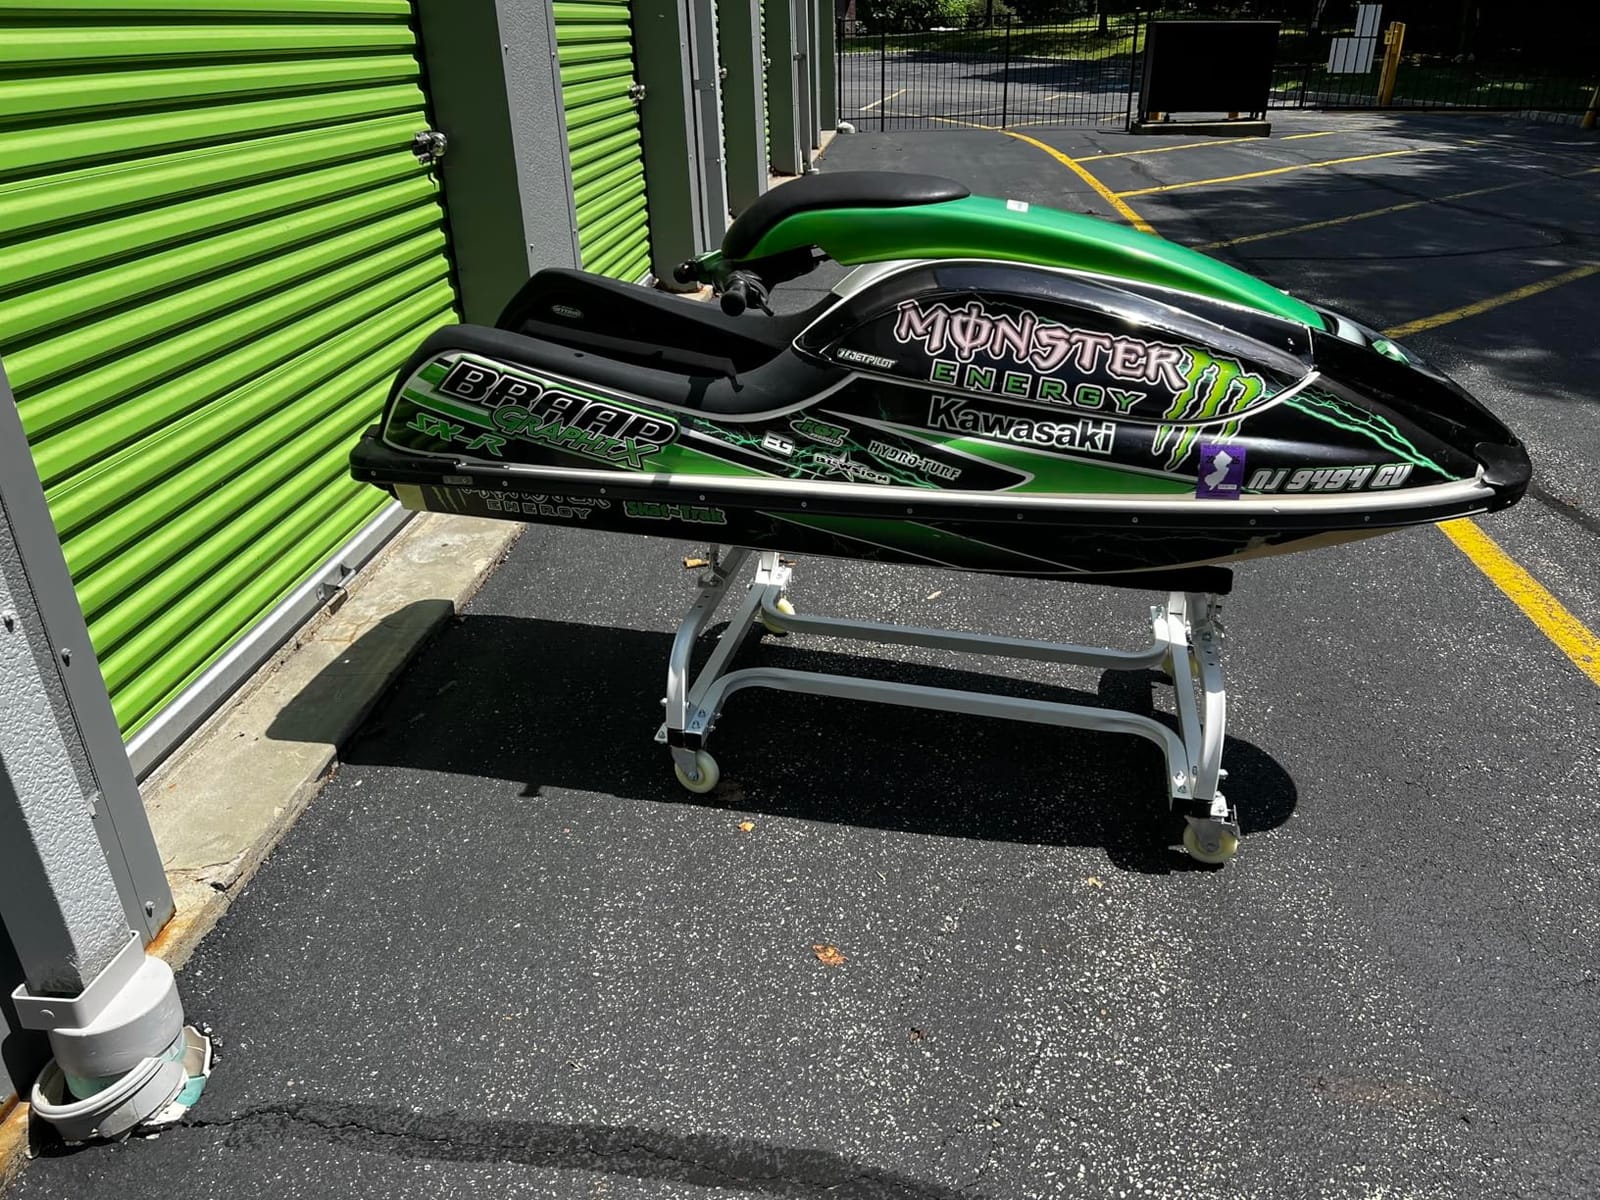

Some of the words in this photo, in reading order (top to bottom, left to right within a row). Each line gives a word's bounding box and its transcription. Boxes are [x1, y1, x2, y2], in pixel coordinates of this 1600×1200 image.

[893, 299, 1189, 392] MONSTER
[438, 360, 677, 444] BRAAP
[929, 358, 1147, 414] ENERGY
[927, 395, 1117, 455] Kawasaki
[868, 439, 963, 481] HYDRO-TURF
[1248, 470, 1287, 490] NJ
[1286, 465, 1373, 490] 9494
[486, 498, 592, 520] ENERGY
